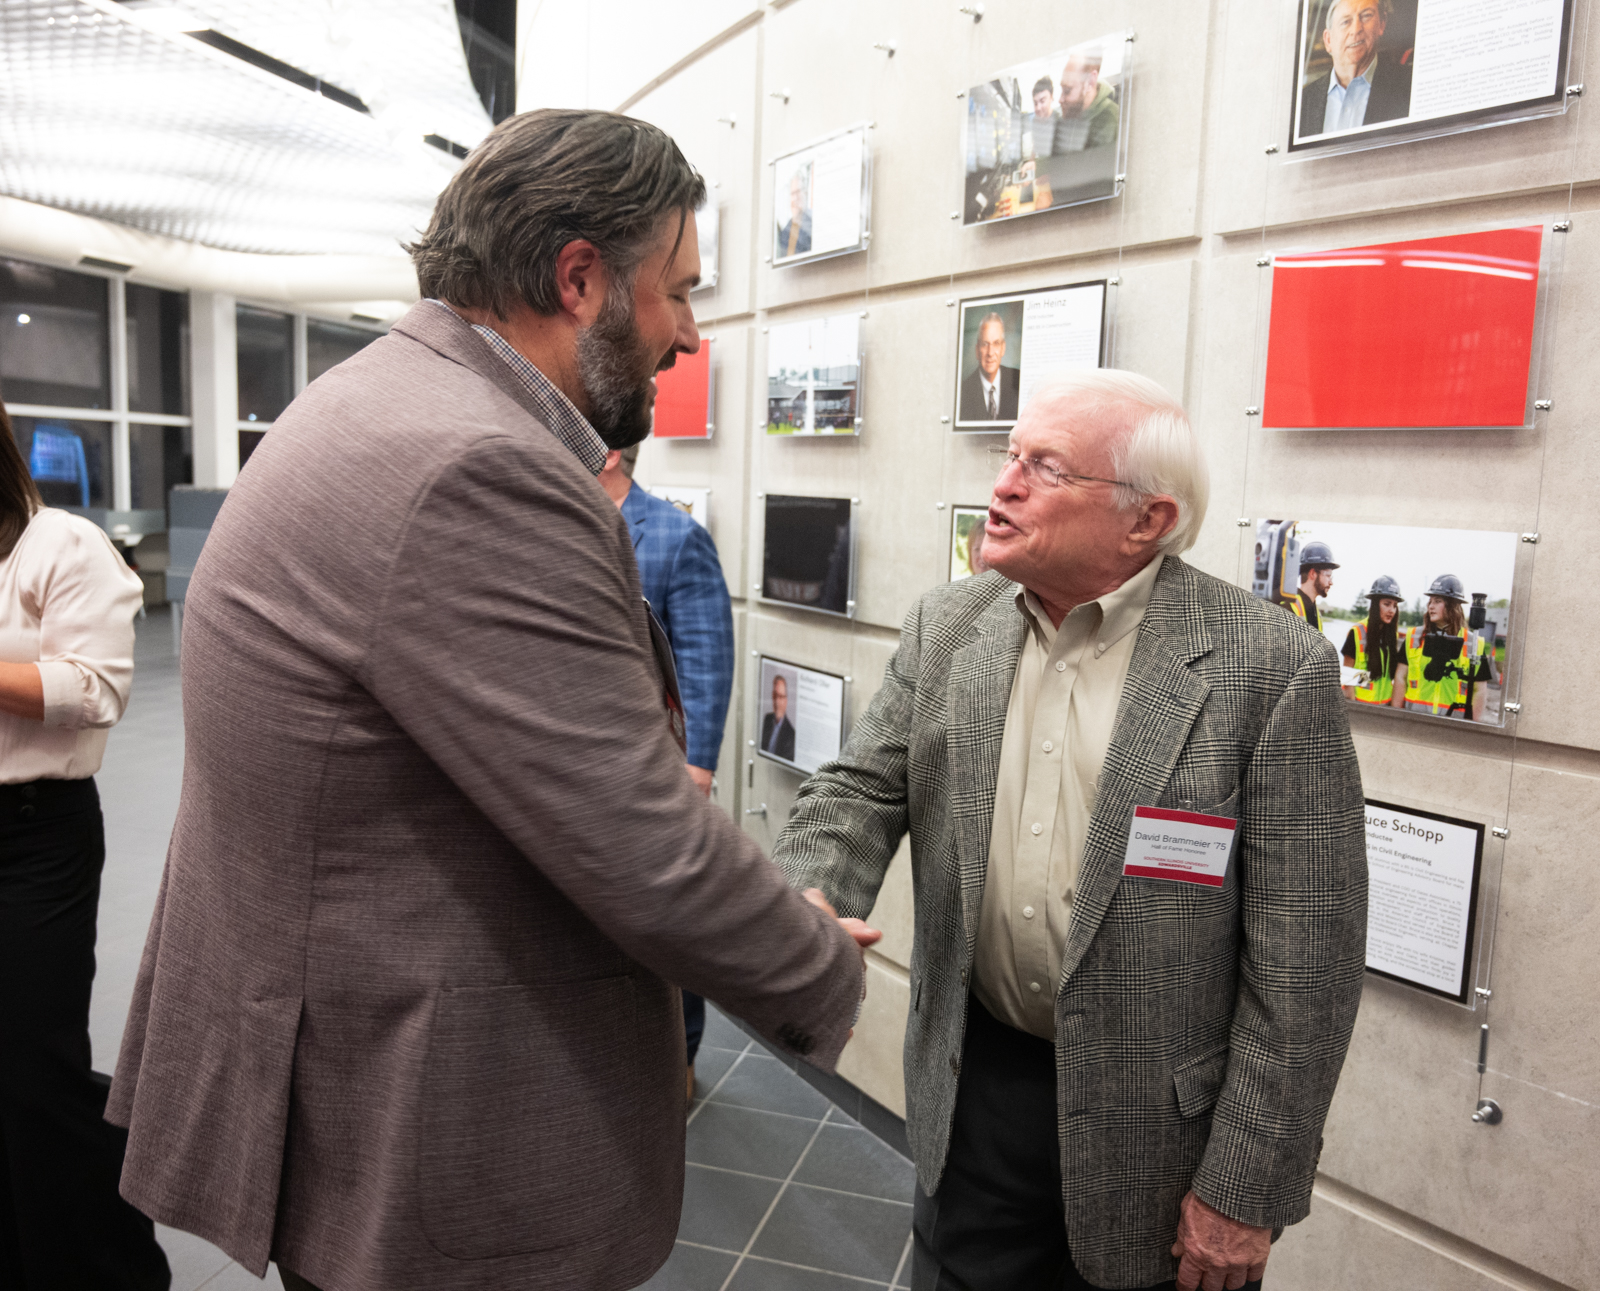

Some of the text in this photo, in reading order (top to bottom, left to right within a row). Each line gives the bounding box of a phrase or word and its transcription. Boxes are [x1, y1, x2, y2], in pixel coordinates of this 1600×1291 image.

[1027, 298, 1067, 311] Jim Heinz
[1365, 816, 1444, 844] uce Schopp
[1367, 832, 1393, 842] nductee
[1134, 832, 1227, 851] David Brammeier '75
[1379, 847, 1393, 856] Civil
[1394, 851, 1432, 866] Engineering
